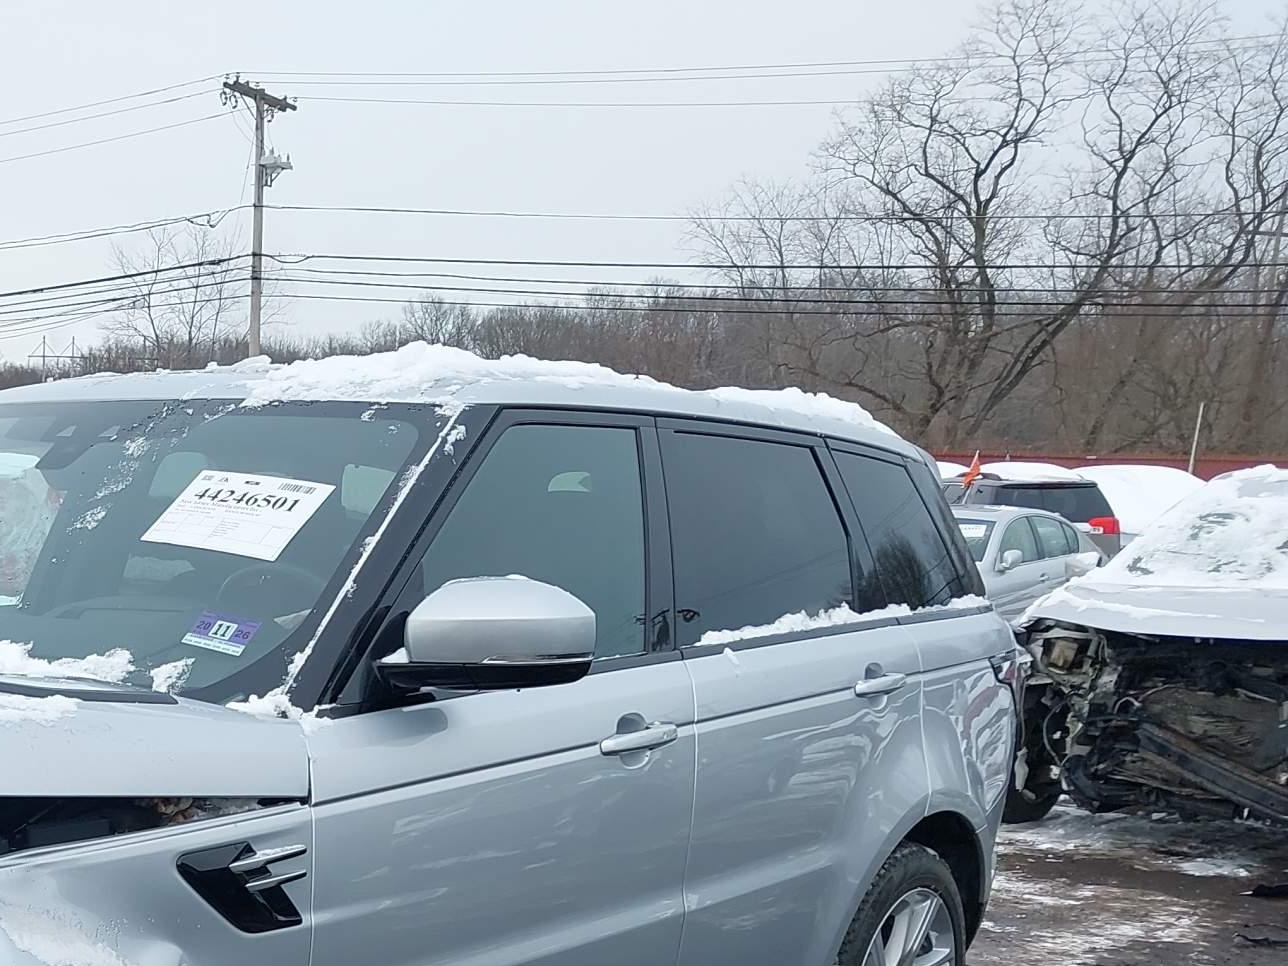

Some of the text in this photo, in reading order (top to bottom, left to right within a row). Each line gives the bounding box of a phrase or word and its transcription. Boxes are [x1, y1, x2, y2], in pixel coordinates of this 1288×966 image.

[194, 487, 301, 513] 44246501
[196, 620, 251, 640] 20 11 26
